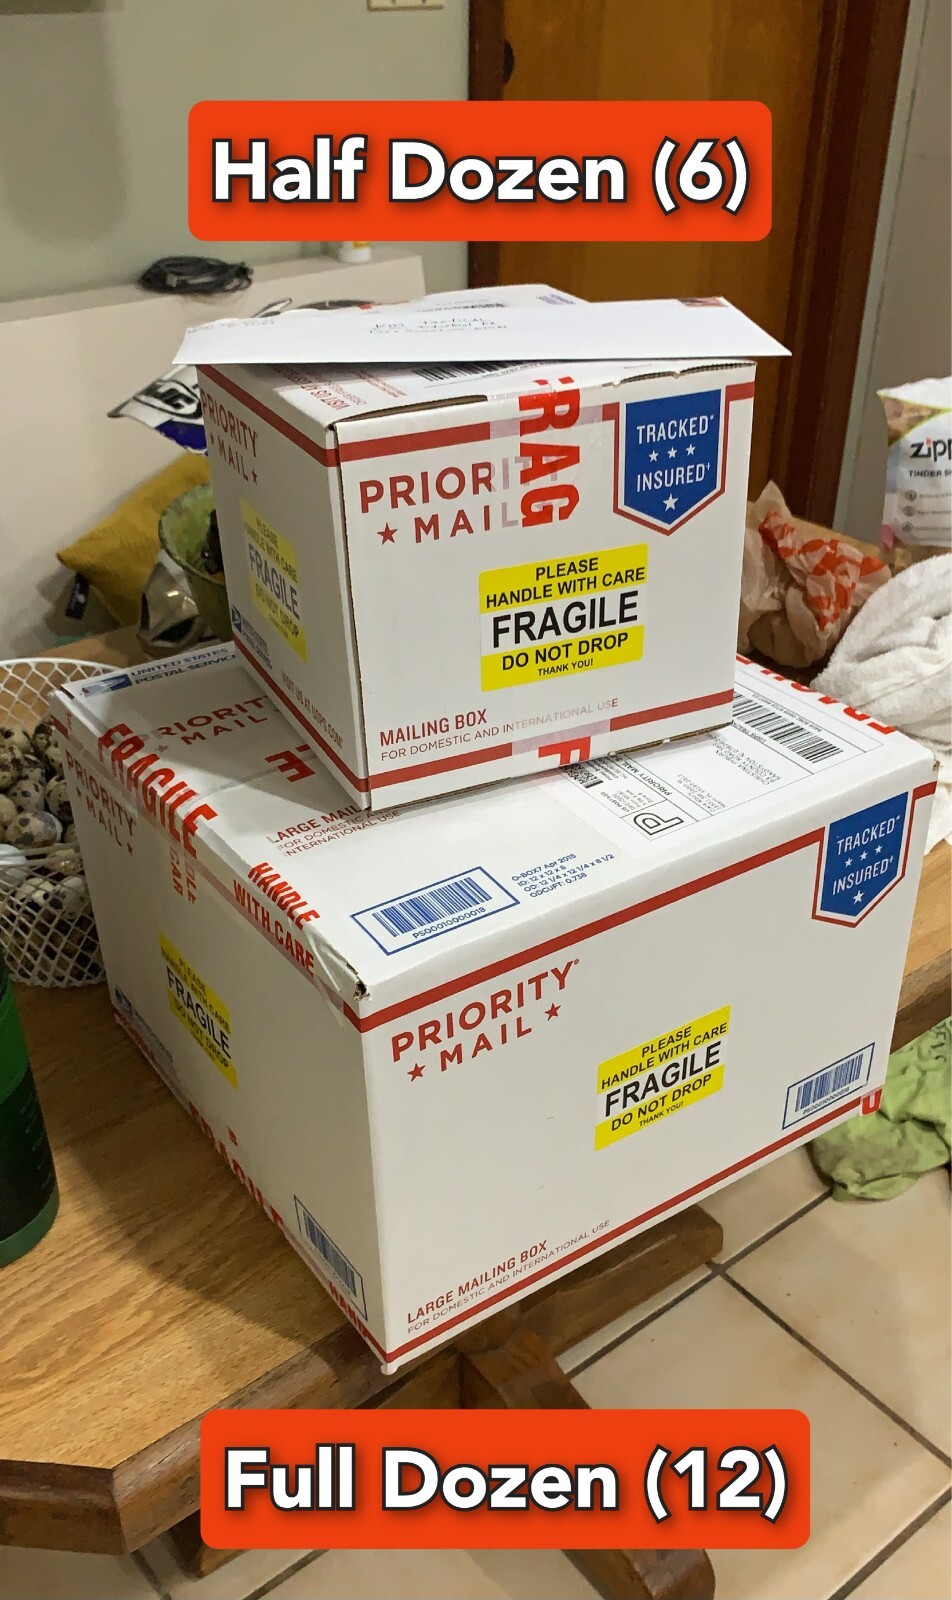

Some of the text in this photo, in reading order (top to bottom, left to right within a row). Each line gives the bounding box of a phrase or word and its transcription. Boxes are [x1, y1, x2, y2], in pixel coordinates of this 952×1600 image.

[200, 387, 258, 458] PRIORITY
[217, 435, 249, 481] MAIL
[414, 502, 519, 544] MAIL
[248, 541, 301, 622] FRAGILE
[486, 567, 646, 609] HANDLE WITH CARE
[536, 557, 599, 581] PLEASE
[493, 590, 639, 649] FRAGILE
[131, 647, 229, 677] UNITED STATES
[502, 632, 629, 671] DO NOT DROP
[537, 657, 594, 677] THANK YOU!
[135, 667, 189, 686] POSTAL
[144, 695, 269, 741] RIORIT
[180, 715, 268, 746] MAIL
[380, 708, 488, 748] MAILING BOX
[381, 698, 619, 762] FOR DOMESTIC AND INTERNATIONAL USE
[97, 722, 219, 860] FRAGILE
[638, 771, 673, 797] PRIORITY
[265, 818, 321, 844] LARGE
[276, 837, 302, 851] FOR
[303, 815, 365, 842] DOMESTIC
[283, 810, 402, 857] INTERNATIONAL USE
[247, 861, 321, 931] HANDLE
[233, 879, 316, 978] WITH CARE
[166, 964, 233, 1061] FRAGILE
[440, 1015, 532, 1072] MAIL
[601, 1022, 727, 1090] HANDLE WITH CARE
[641, 1026, 692, 1058] PLEASE
[605, 1040, 721, 1118] FRAGILE
[611, 1073, 712, 1131] DO NOT DROP
[638, 1110, 664, 1127] THANK
[407, 1219, 611, 1334] FOR DOMESTIC AND INTERNATIONAL USE
[407, 1290, 454, 1324] LARGE
[457, 1257, 517, 1297] MAILING
[520, 1239, 548, 1263] BOX
